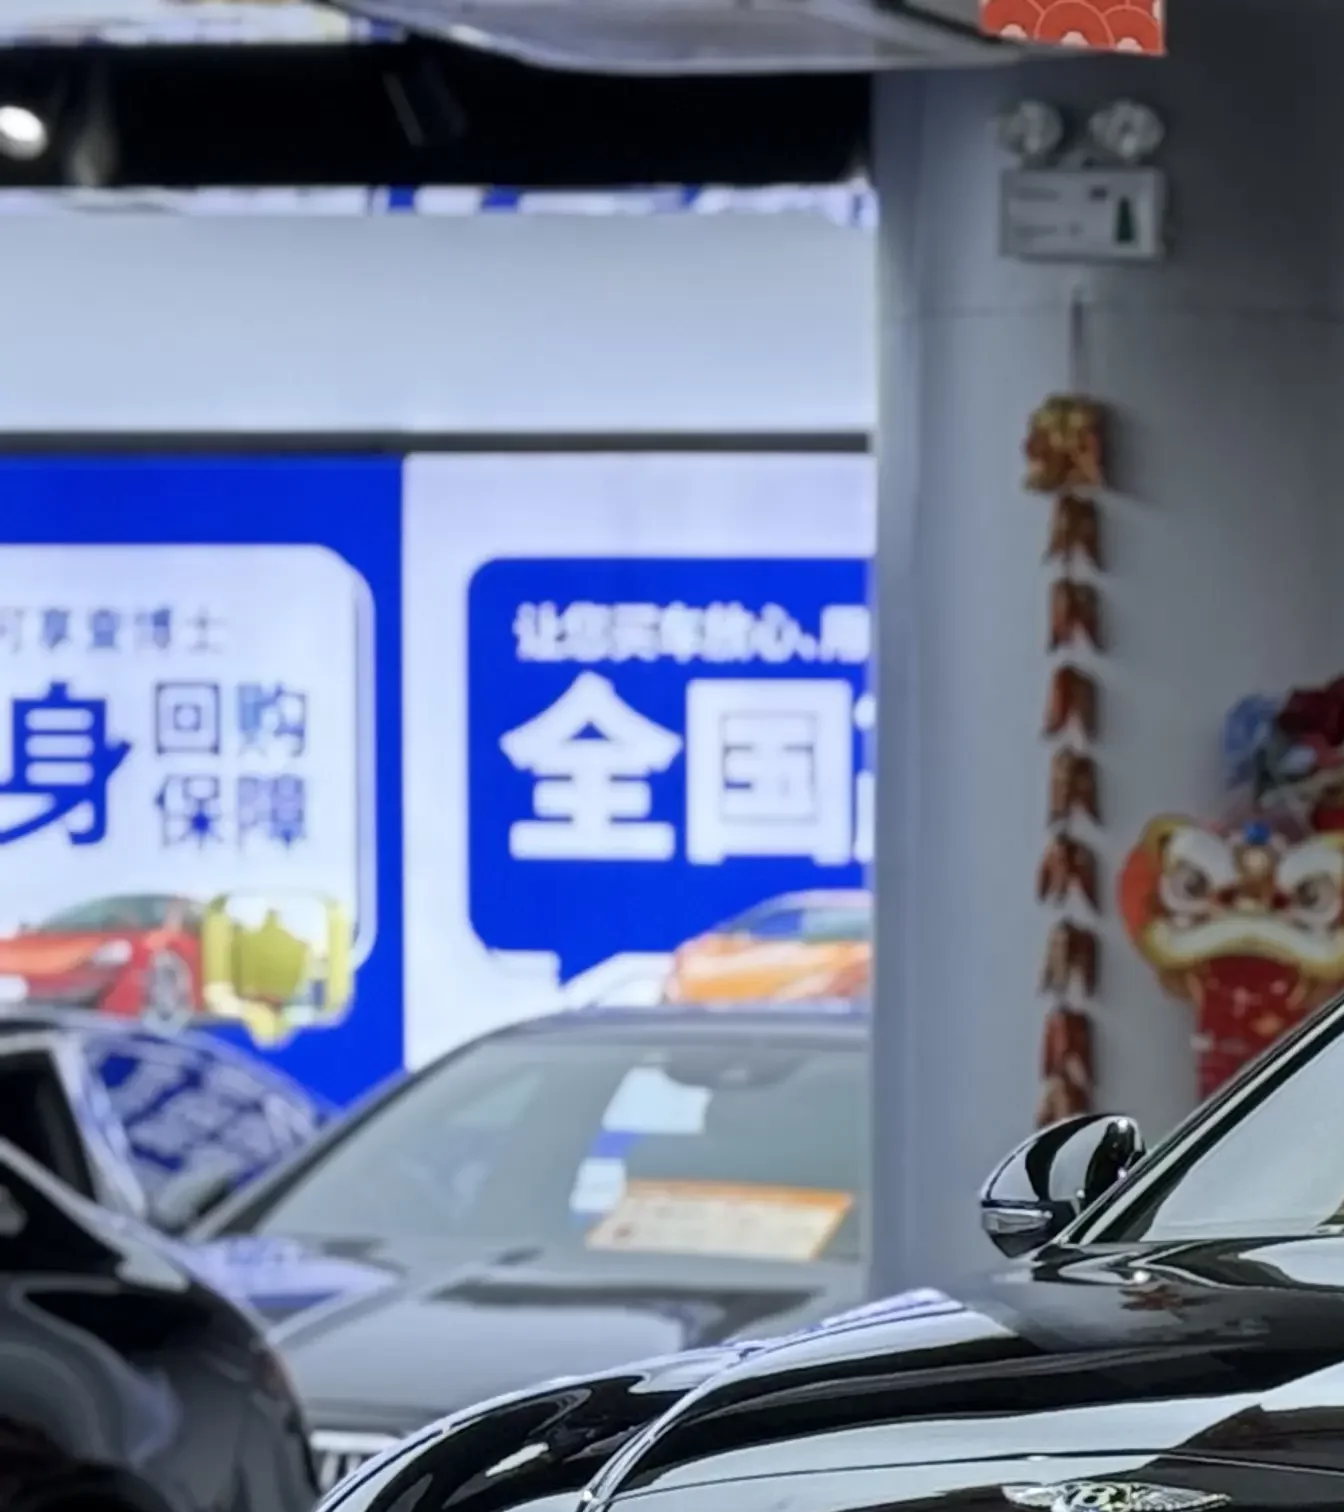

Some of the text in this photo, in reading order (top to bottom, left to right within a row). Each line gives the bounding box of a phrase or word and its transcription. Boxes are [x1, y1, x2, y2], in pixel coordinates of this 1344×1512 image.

[0, 681, 132, 846] 身
[155, 681, 307, 758] 回购
[499, 670, 876, 868] 全国
[153, 773, 308, 852] 保障
